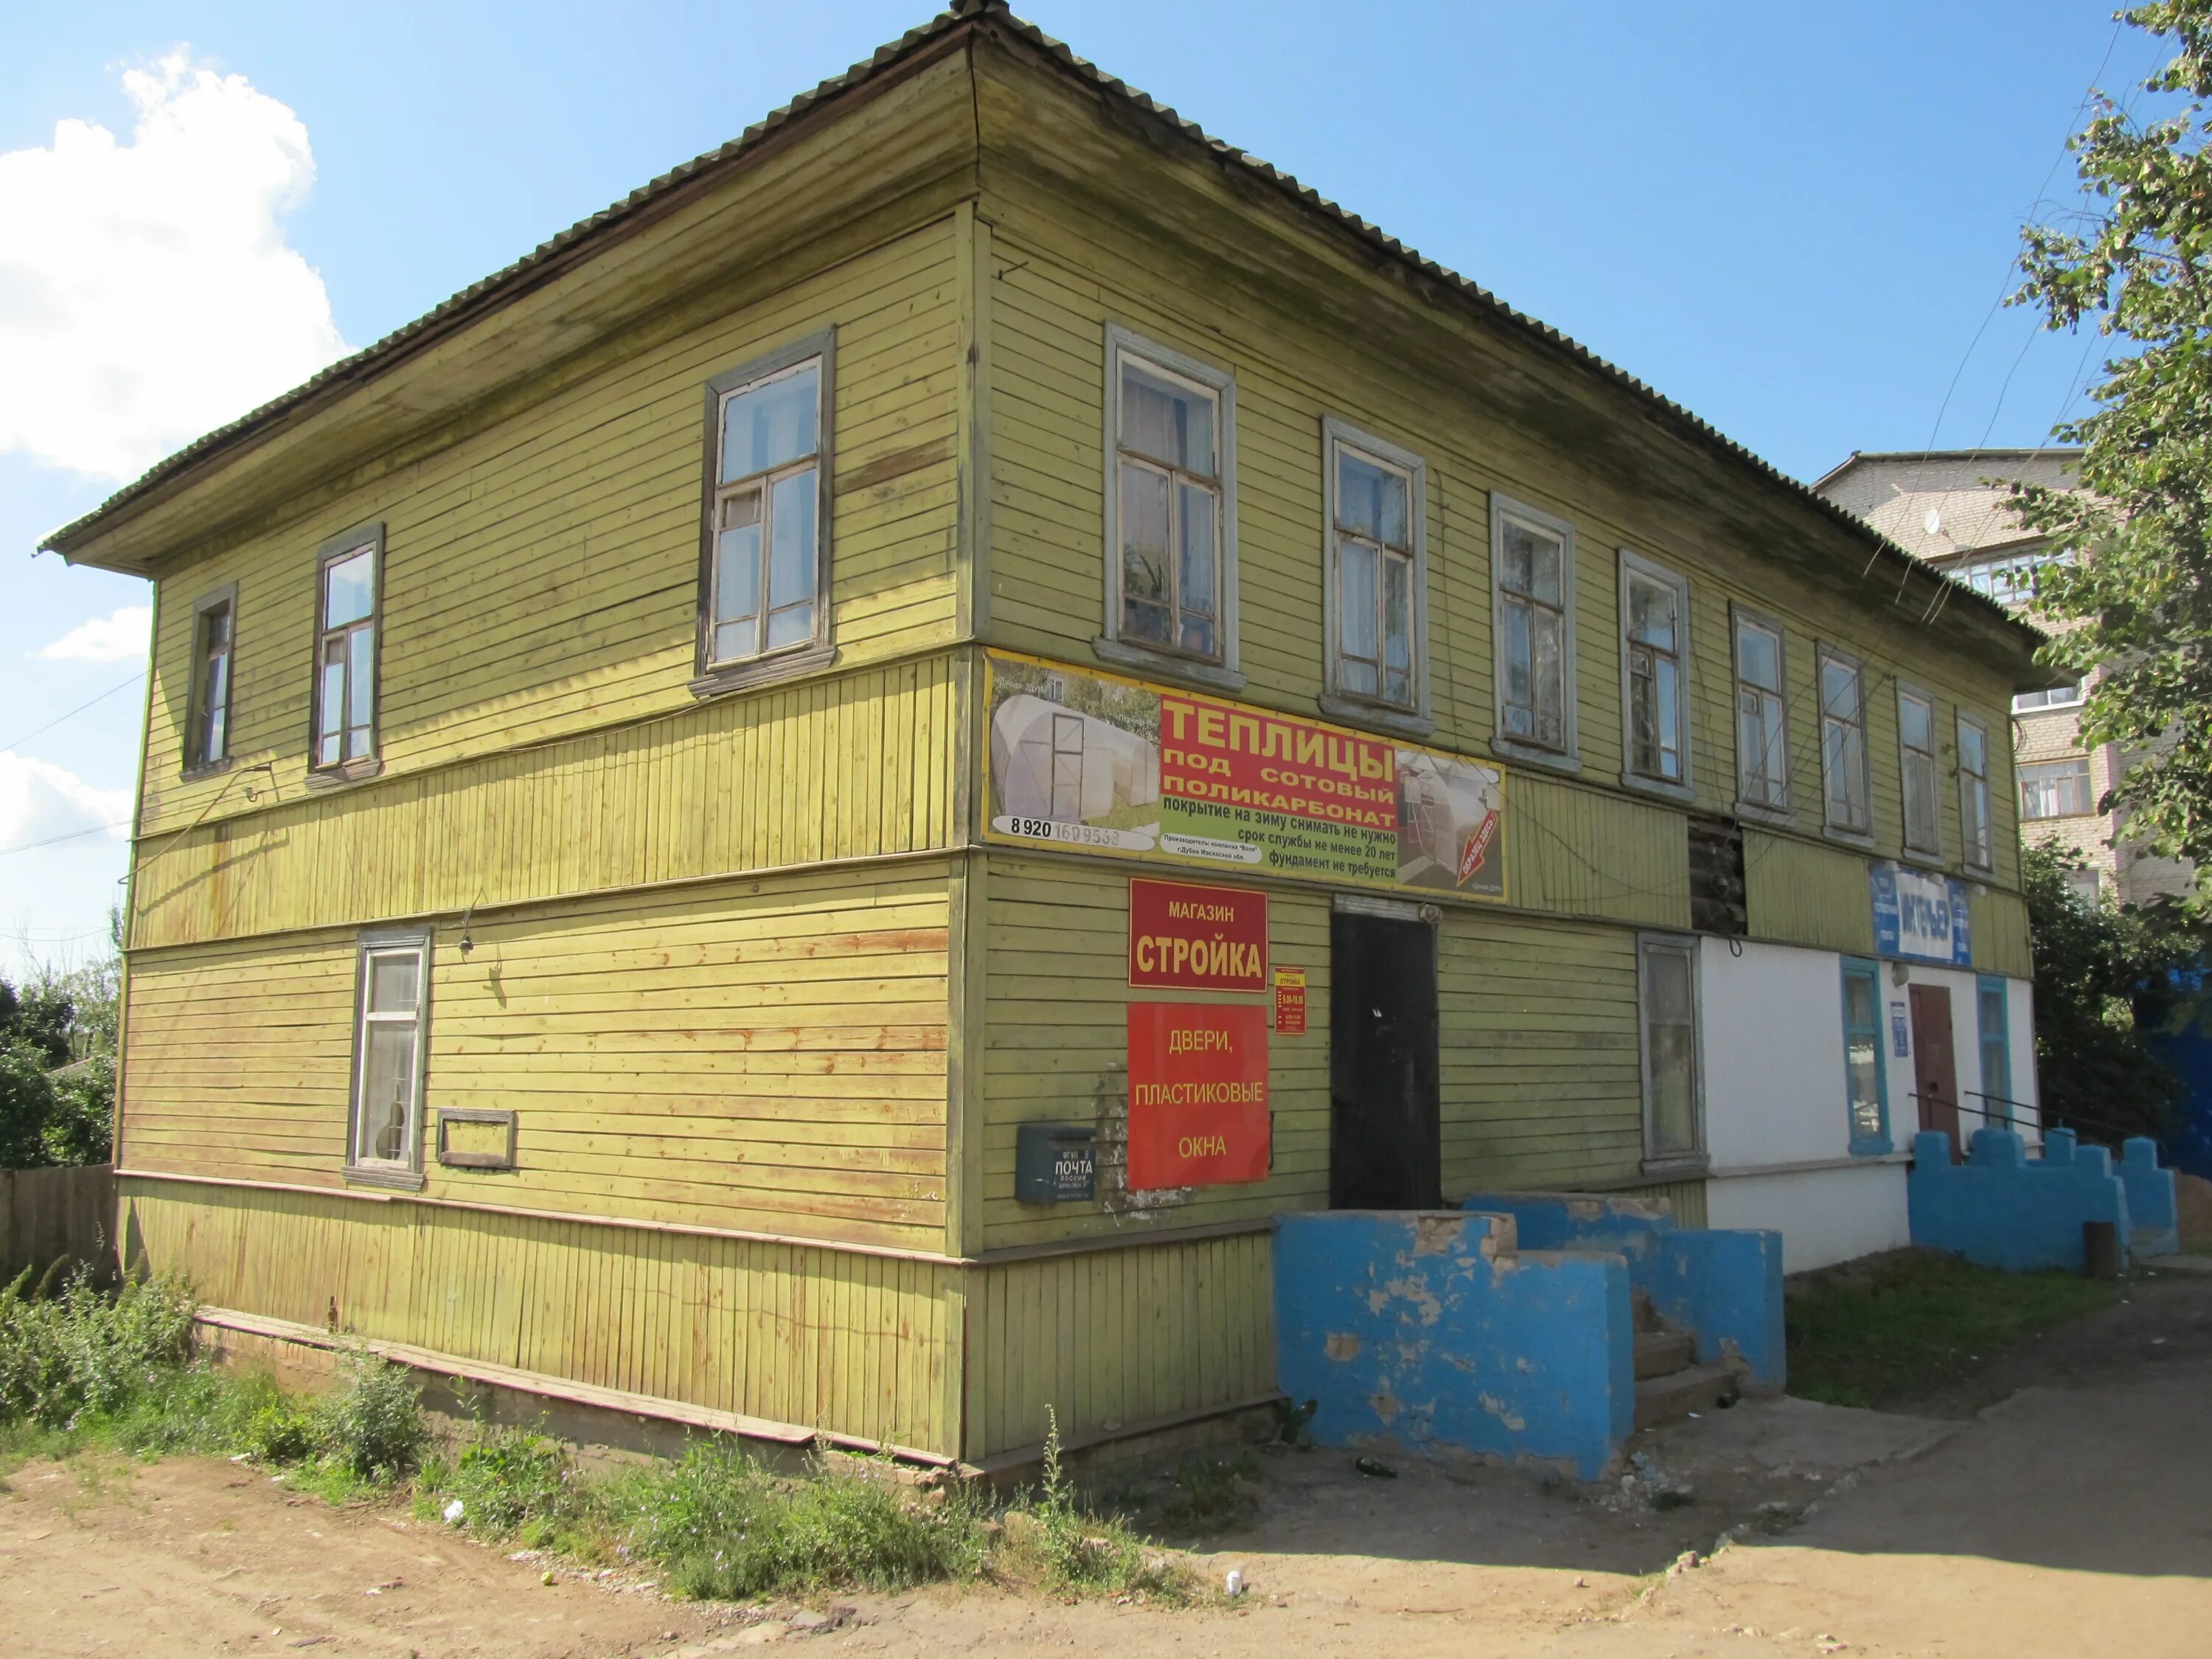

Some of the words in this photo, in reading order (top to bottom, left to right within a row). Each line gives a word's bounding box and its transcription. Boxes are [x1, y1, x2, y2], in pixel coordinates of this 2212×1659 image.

[1163, 700, 1394, 782] ТЕПЛИЦЫ
[1164, 748, 1231, 776] ПОД
[1261, 768, 1394, 804] СОТОВЫЙ
[1164, 775, 1396, 827] ПОЛИКАРБОНАТ
[1011, 817, 1020, 834] 8
[1023, 819, 1051, 838] 920
[1164, 797, 1231, 817] покрытие
[1235, 808, 1251, 822] на
[1255, 812, 1287, 831] зиму
[1290, 815, 1340, 835] снимать
[1343, 825, 1357, 838] не
[1361, 827, 1396, 845] нужно
[1164, 834, 1210, 846] Производитель:
[1238, 829, 1265, 843] срок
[1268, 833, 1312, 849] службы
[1315, 841, 1327, 851] не
[1330, 843, 1362, 856] менее
[1365, 845, 1376, 858] 20
[1379, 849, 1396, 860] лет
[1269, 849, 1329, 869] фундамент
[1332, 860, 1345, 872] не
[1348, 862, 1396, 878] требуется
[1463, 841, 1483, 874] ОБРАЗЕЦ
[1169, 901, 1234, 922] МАГАЗИН
[1136, 933, 1262, 978] СТРОЙКА
[1169, 1030, 1233, 1054] ДВЕРИ,
[1135, 1082, 1264, 1105] ПЛАСТИКОВЫЕ
[1062, 1151, 1078, 1160] ФГУП
[1179, 1136, 1226, 1158] ОКНА
[1055, 1161, 1093, 1175] ПОЧТА
